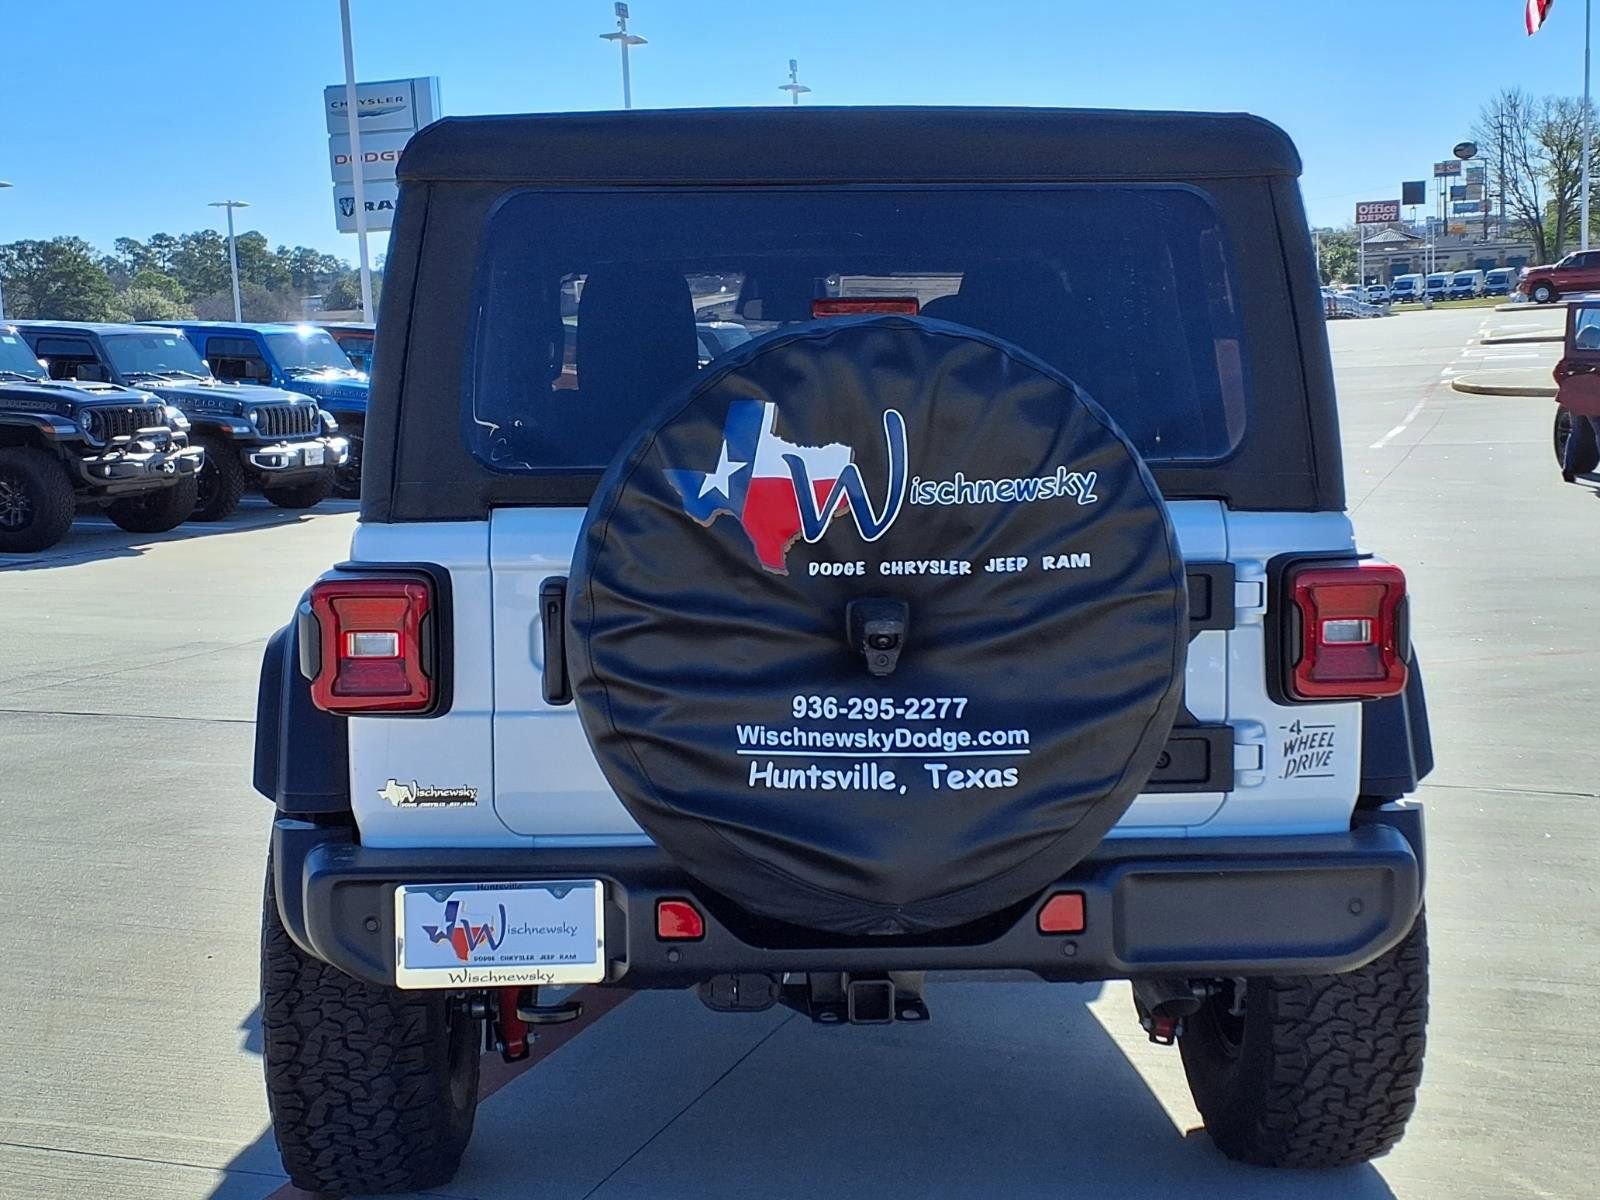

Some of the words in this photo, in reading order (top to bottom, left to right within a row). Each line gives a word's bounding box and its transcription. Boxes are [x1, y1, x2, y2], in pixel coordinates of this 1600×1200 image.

[331, 96, 404, 108] CHYSLER
[364, 199, 397, 212] RA
[1358, 203, 1398, 214] Office
[1359, 212, 1397, 222] DEPOT
[781, 408, 1098, 544] Wischnewsky
[808, 560, 866, 577] DODGE
[879, 559, 972, 577] CHRYSLER
[984, 556, 1029, 573] JEEP
[1042, 552, 1092, 570] RAM
[791, 695, 969, 721] 936-295-2277
[736, 724, 1030, 752] WischnewskyDodge.com
[1289, 719, 1302, 735] 4
[1283, 732, 1335, 757] WHEEL
[748, 760, 908, 794] Huntsville,
[924, 763, 1019, 790] Texas
[1284, 751, 1335, 779] DRIVE
[400, 779, 478, 803] Wischnewsky
[460, 903, 579, 952] Wischnewsky
[448, 968, 555, 984] Wischnewsky
